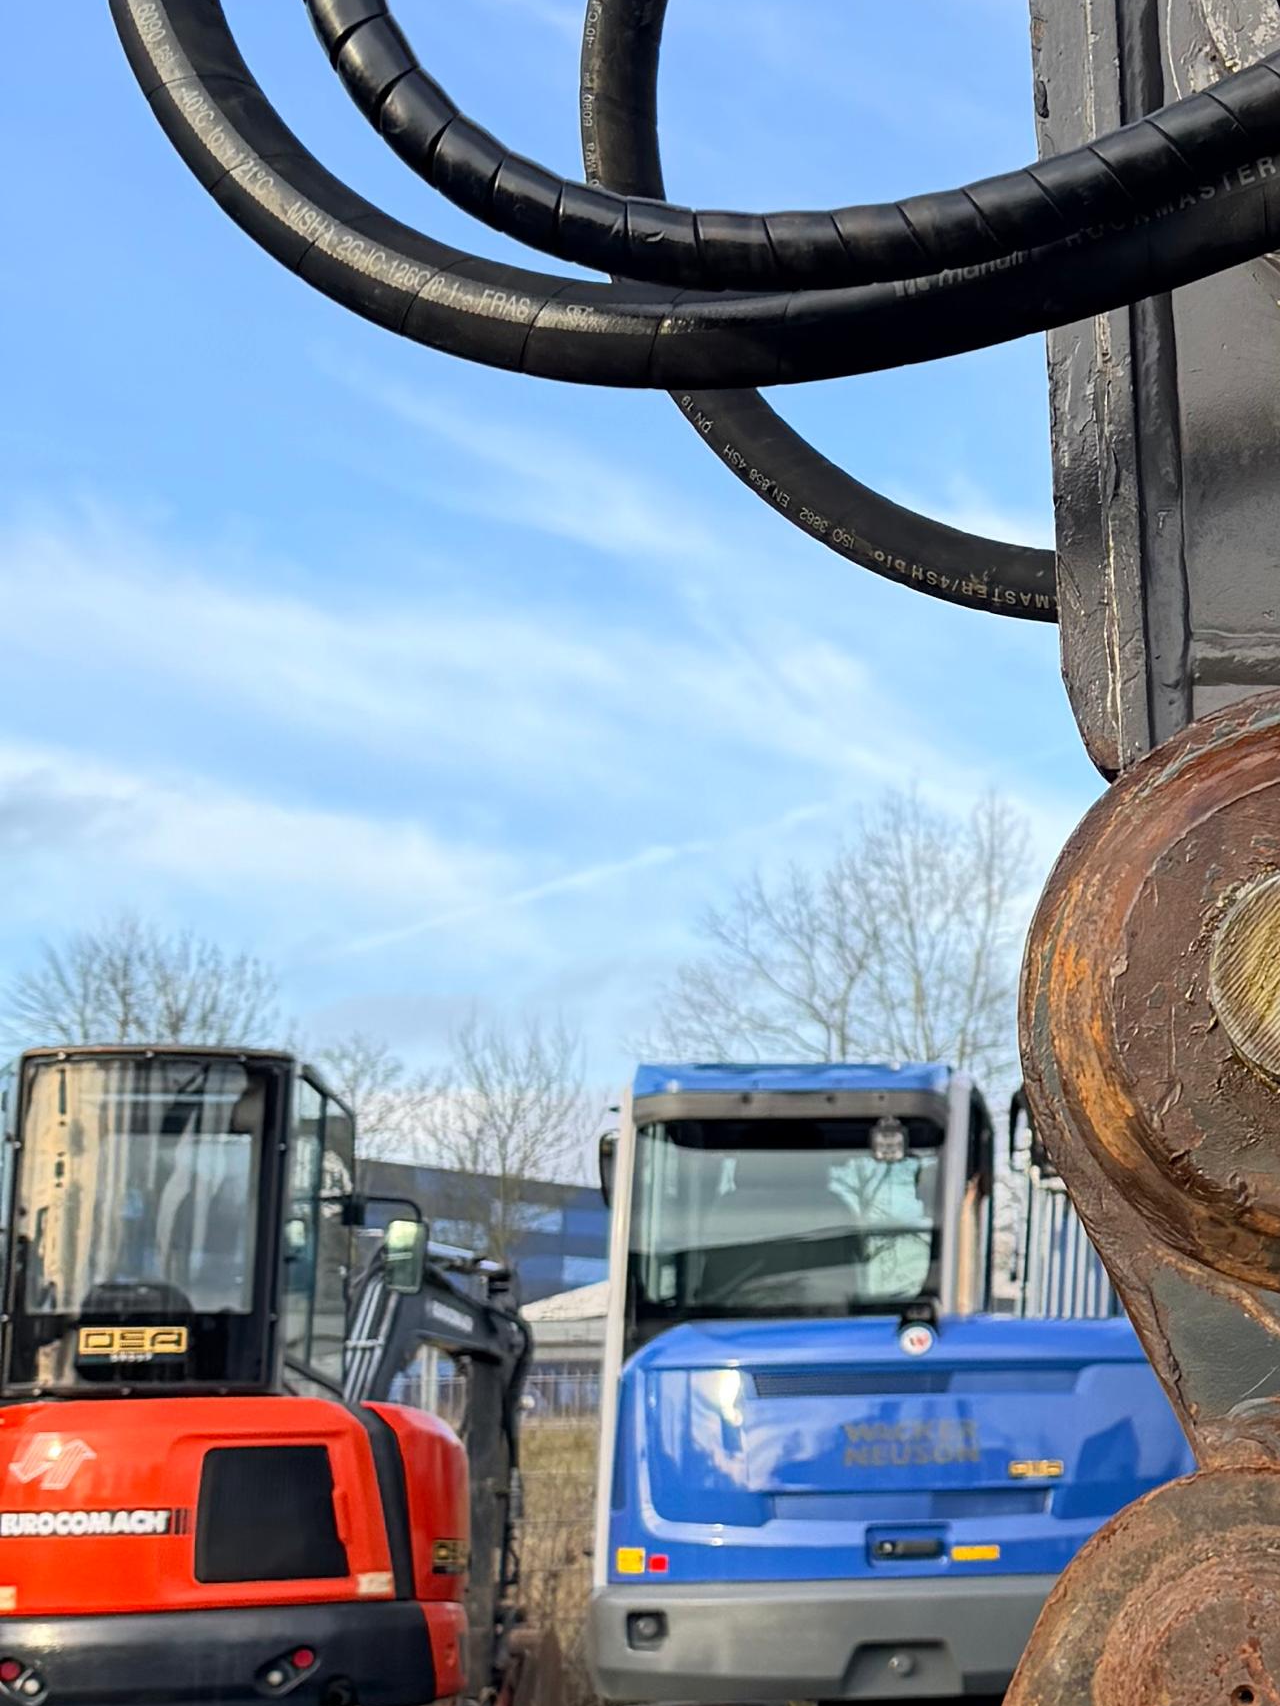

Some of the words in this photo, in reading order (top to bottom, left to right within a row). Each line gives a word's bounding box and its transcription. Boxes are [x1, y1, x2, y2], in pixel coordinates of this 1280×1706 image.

[136, 3, 167, 43] 6090
[156, 45, 180, 66] psi
[208, 124, 227, 146] to
[285, 200, 336, 245] MSHA
[723, 443, 748, 473] 4SH
[832, 526, 856, 550] ISO
